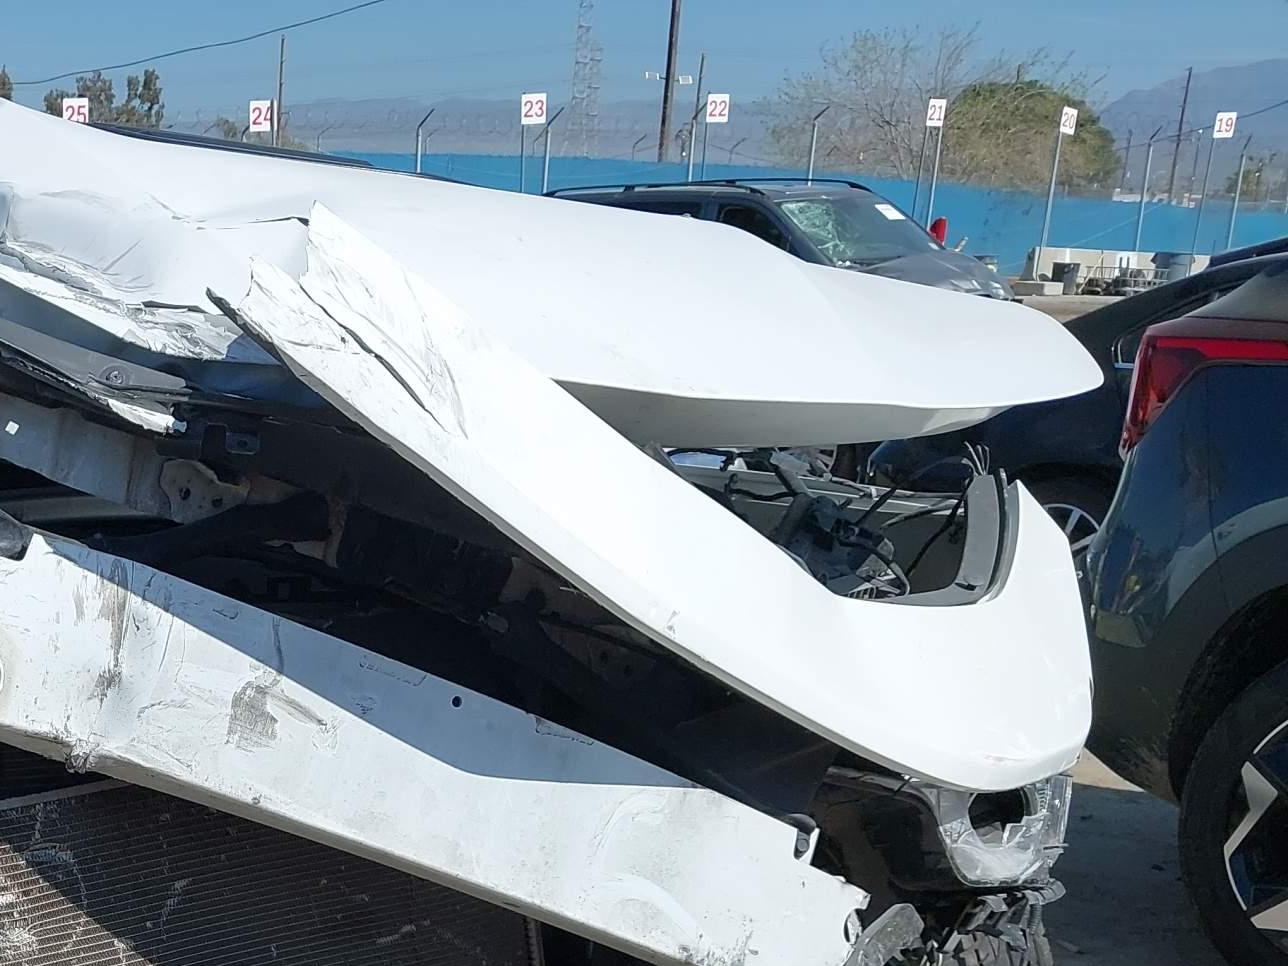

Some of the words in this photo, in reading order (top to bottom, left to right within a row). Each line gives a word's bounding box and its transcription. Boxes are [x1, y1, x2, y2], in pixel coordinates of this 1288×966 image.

[65, 105, 87, 123] 25
[252, 106, 272, 125] 24
[524, 100, 545, 118] 23
[708, 100, 727, 117] 22
[929, 104, 943, 121] 21
[1062, 111, 1075, 129] 20
[1217, 117, 1233, 133] 19
